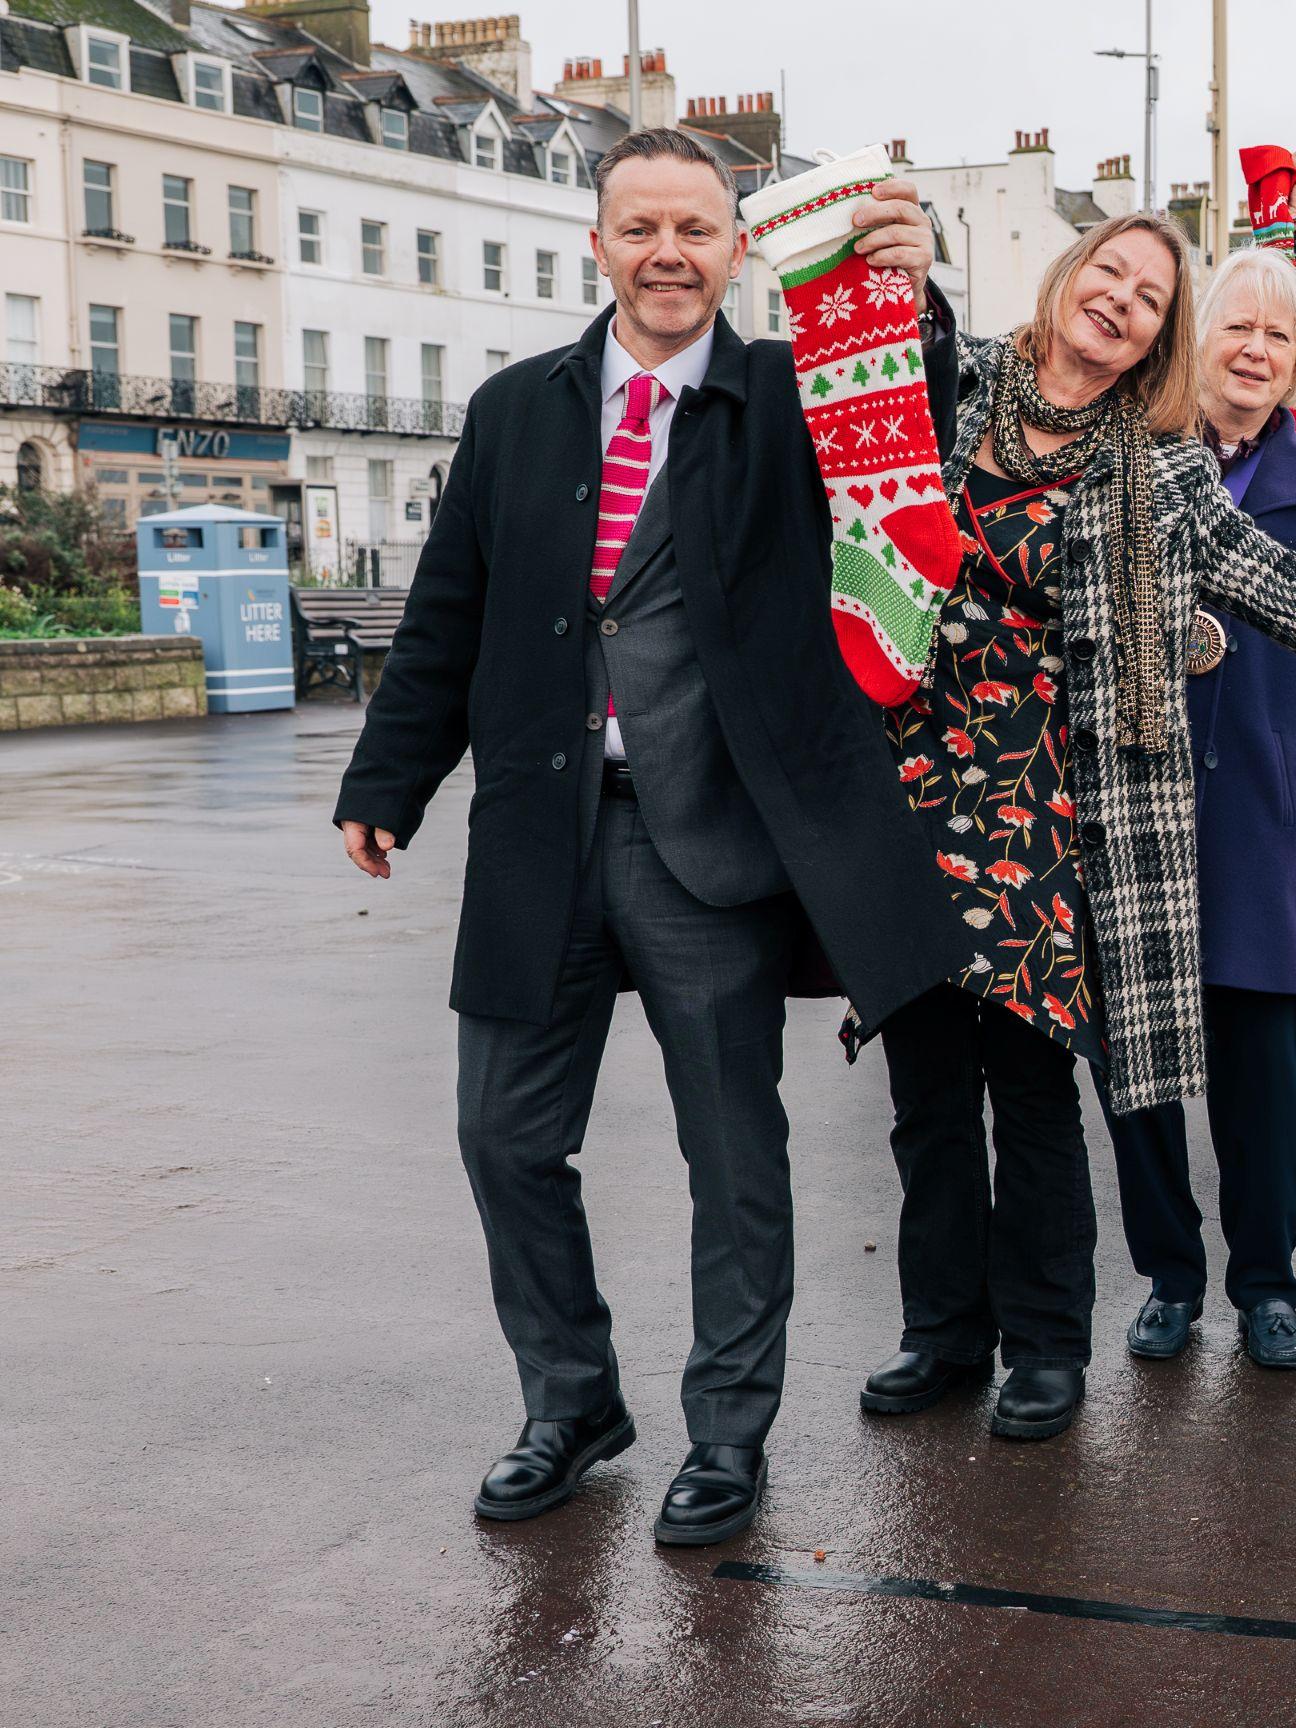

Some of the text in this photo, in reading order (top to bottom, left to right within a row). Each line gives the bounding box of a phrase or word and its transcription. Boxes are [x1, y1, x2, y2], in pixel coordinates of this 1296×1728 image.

[167, 552, 191, 562] Litter
[249, 552, 269, 562] Litter
[240, 603, 282, 621] LITTER
[245, 624, 281, 641] HERE
